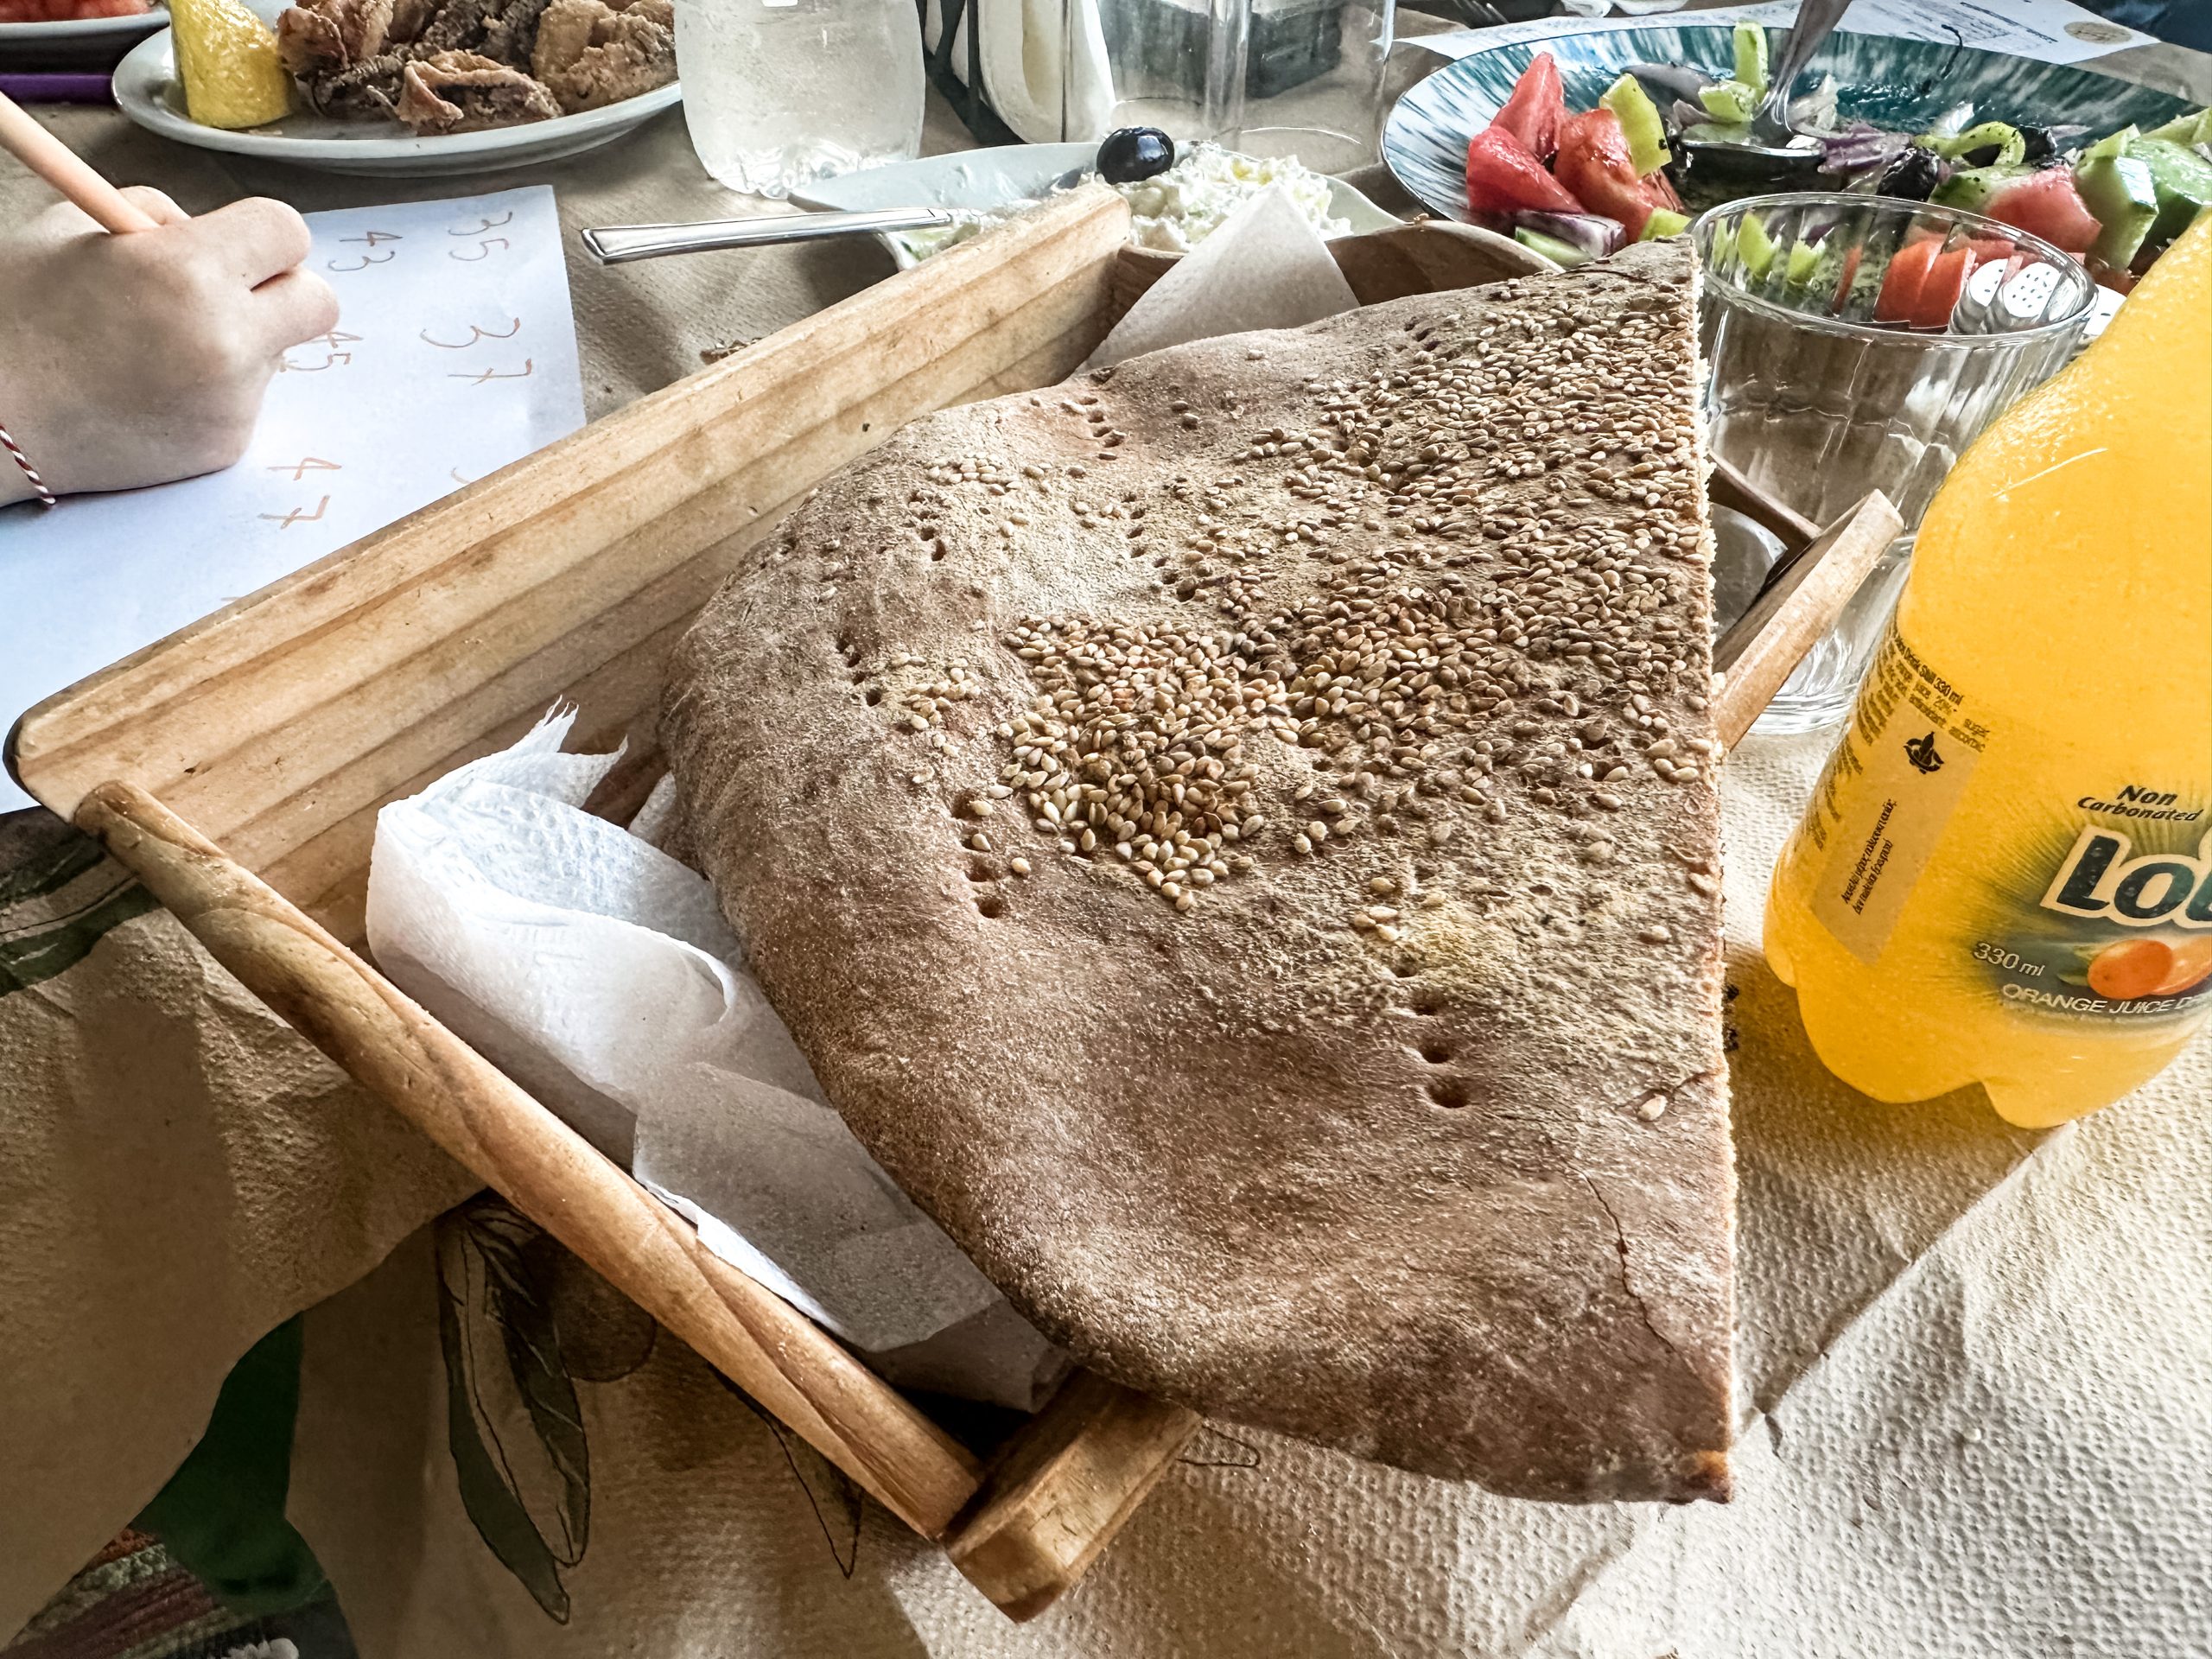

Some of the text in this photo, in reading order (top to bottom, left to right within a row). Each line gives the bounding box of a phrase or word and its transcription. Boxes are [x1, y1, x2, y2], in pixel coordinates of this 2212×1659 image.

[327, 231, 404, 272] 43
[446, 212, 514, 262] 35
[419, 317, 532, 386] 37
[257, 457, 342, 529] 47
[1934, 677, 1952, 696] 330
[2077, 796, 2204, 822] Carbonated
[2116, 785, 2178, 806] Non
[1974, 942, 2045, 976] 330 ml
[2001, 983, 2108, 1014] ORANGE
[2108, 997, 2176, 1014] JUICE
